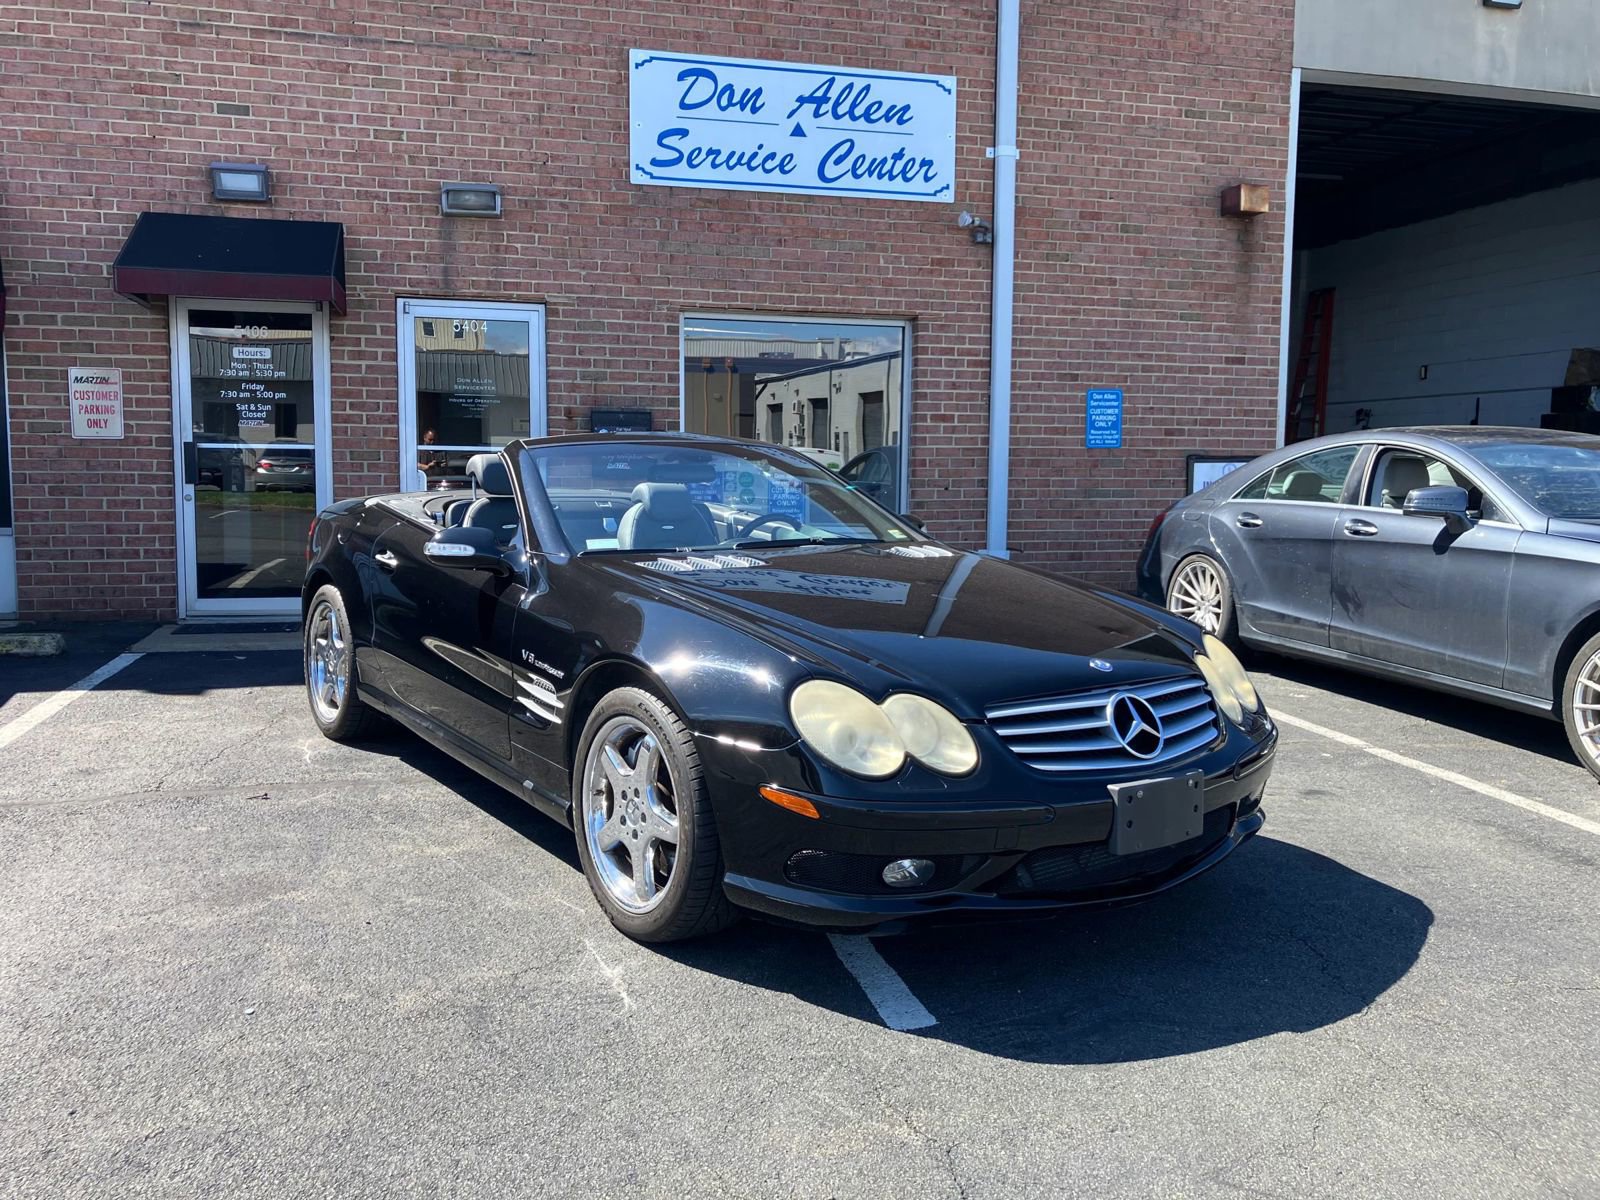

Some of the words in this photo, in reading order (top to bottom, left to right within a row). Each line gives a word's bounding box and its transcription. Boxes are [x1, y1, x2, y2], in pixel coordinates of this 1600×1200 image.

[676, 67, 766, 115] Don
[786, 76, 914, 126] Allen
[649, 127, 797, 175] Service
[817, 138, 938, 184] Center
[234, 325, 268, 338] 5406
[453, 320, 488, 333] 5404
[237, 348, 267, 357] Hours:
[252, 362, 274, 370] Thurs
[255, 369, 273, 377] 5:30
[73, 376, 110, 385] MARTIN
[241, 383, 265, 391] Friday
[73, 390, 119, 401] CUSTOMER
[275, 392, 287, 400] pm
[78, 404, 116, 415] PARKING
[257, 403, 272, 411] Sun
[86, 418, 109, 429] ONLY
